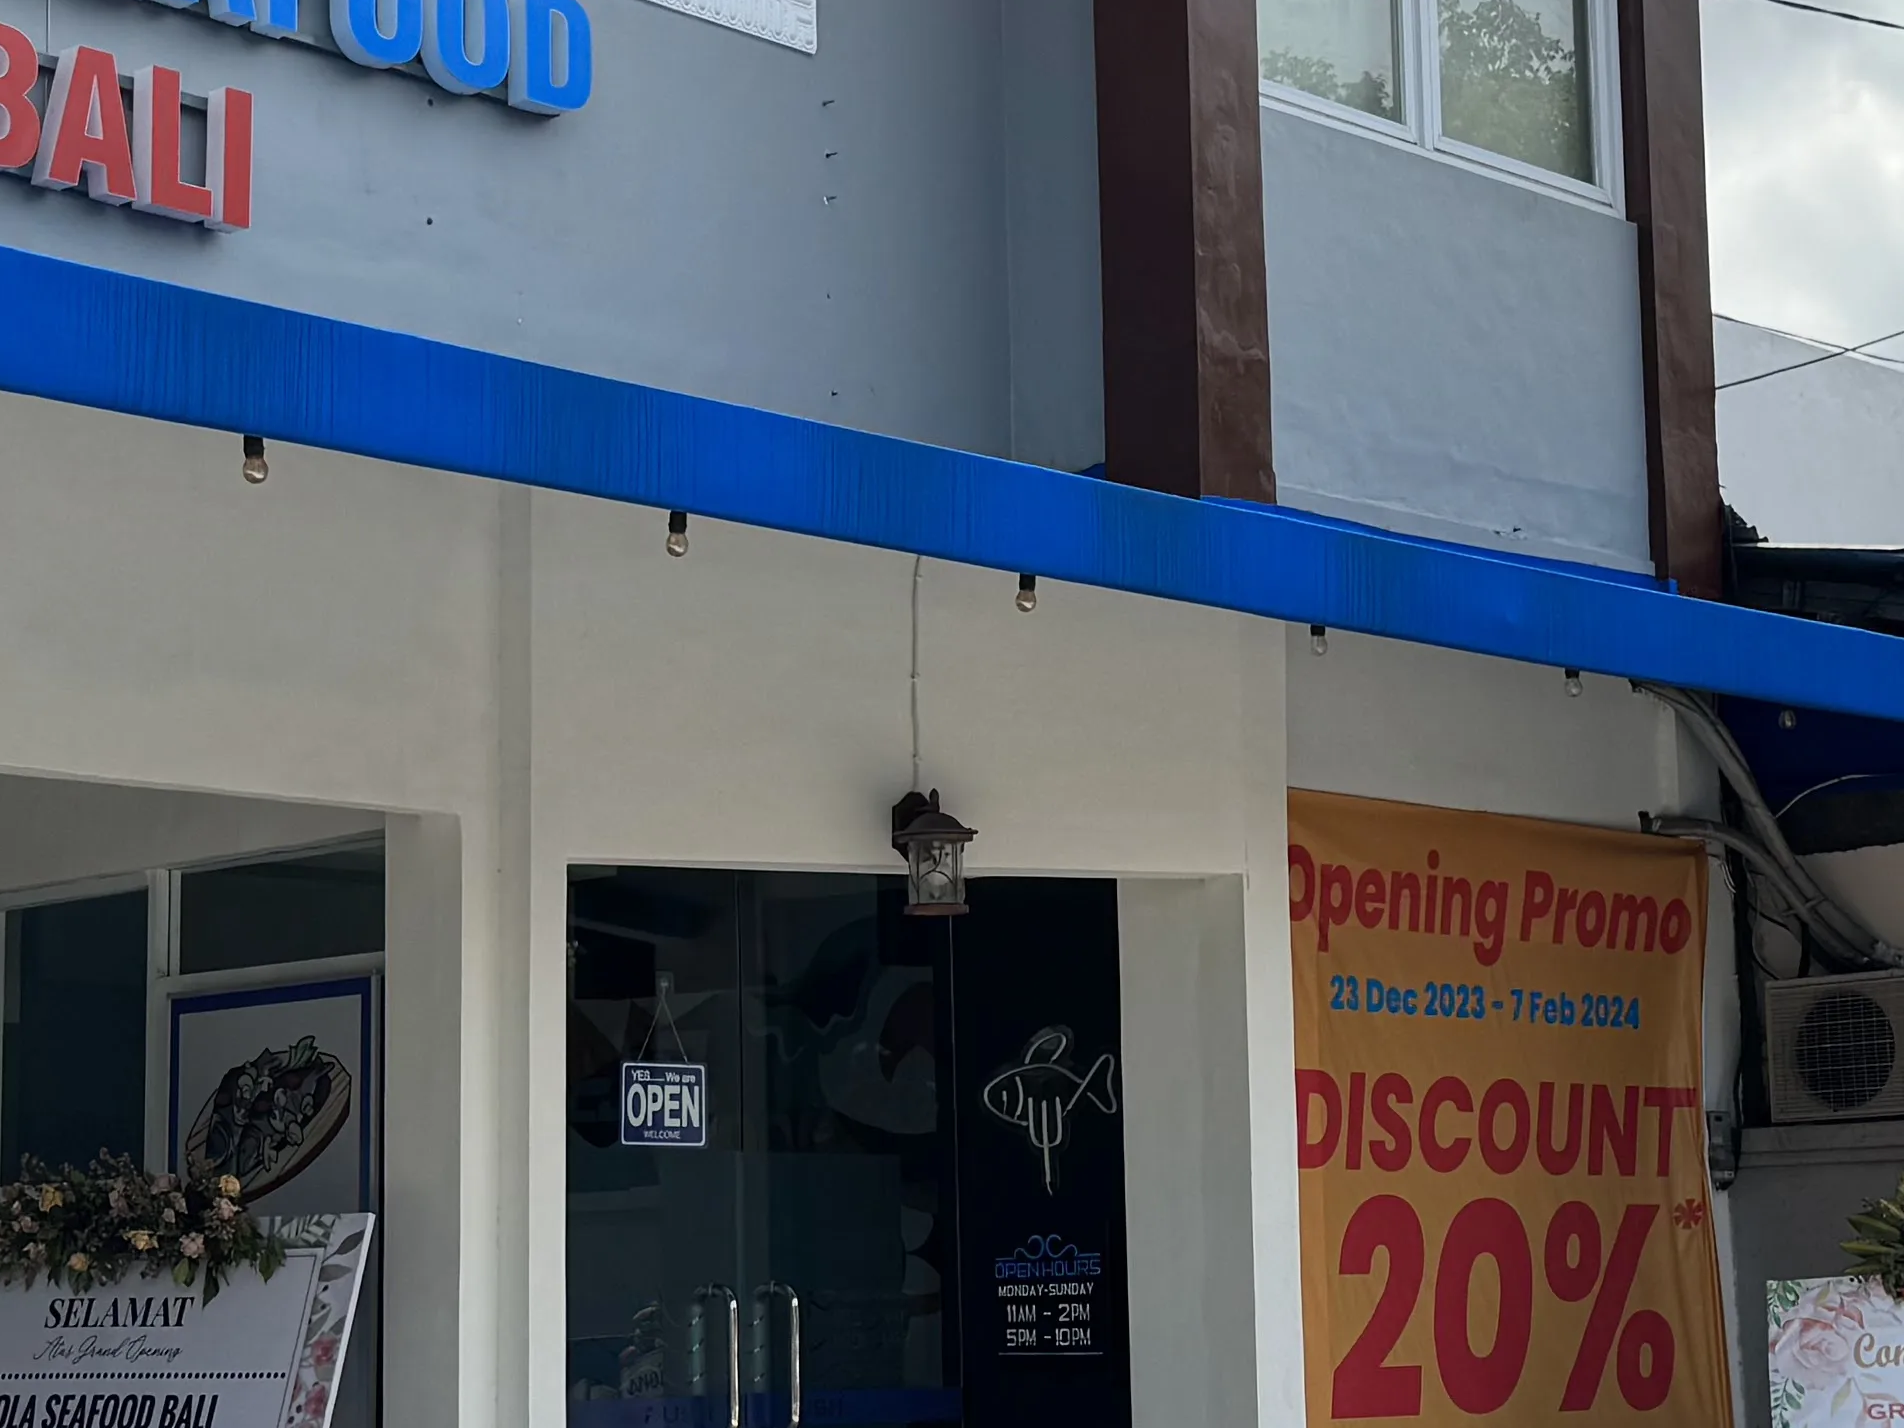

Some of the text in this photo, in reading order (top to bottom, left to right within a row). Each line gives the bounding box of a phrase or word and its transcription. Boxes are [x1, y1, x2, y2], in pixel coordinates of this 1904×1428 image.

[1288, 844, 1693, 967] Opening Promo
[1330, 974, 1359, 1011] 23
[1366, 978, 1418, 1015] Dec
[1423, 981, 1486, 1020] 2023
[1510, 989, 1523, 1022] 7
[1529, 991, 1575, 1025] Feb
[1581, 993, 1640, 1030] 2024
[627, 1083, 700, 1127] OPEN
[1295, 1067, 1697, 1178] DISCOUNT
[995, 1259, 1101, 1279] OPEN HOURS
[44, 1296, 195, 1329] SELAMAT
[1007, 1304, 1036, 1323] 11AM
[1058, 1303, 1090, 1322] 2PM
[72, 1335, 130, 1365] Grand
[1006, 1328, 1036, 1347] 5PM
